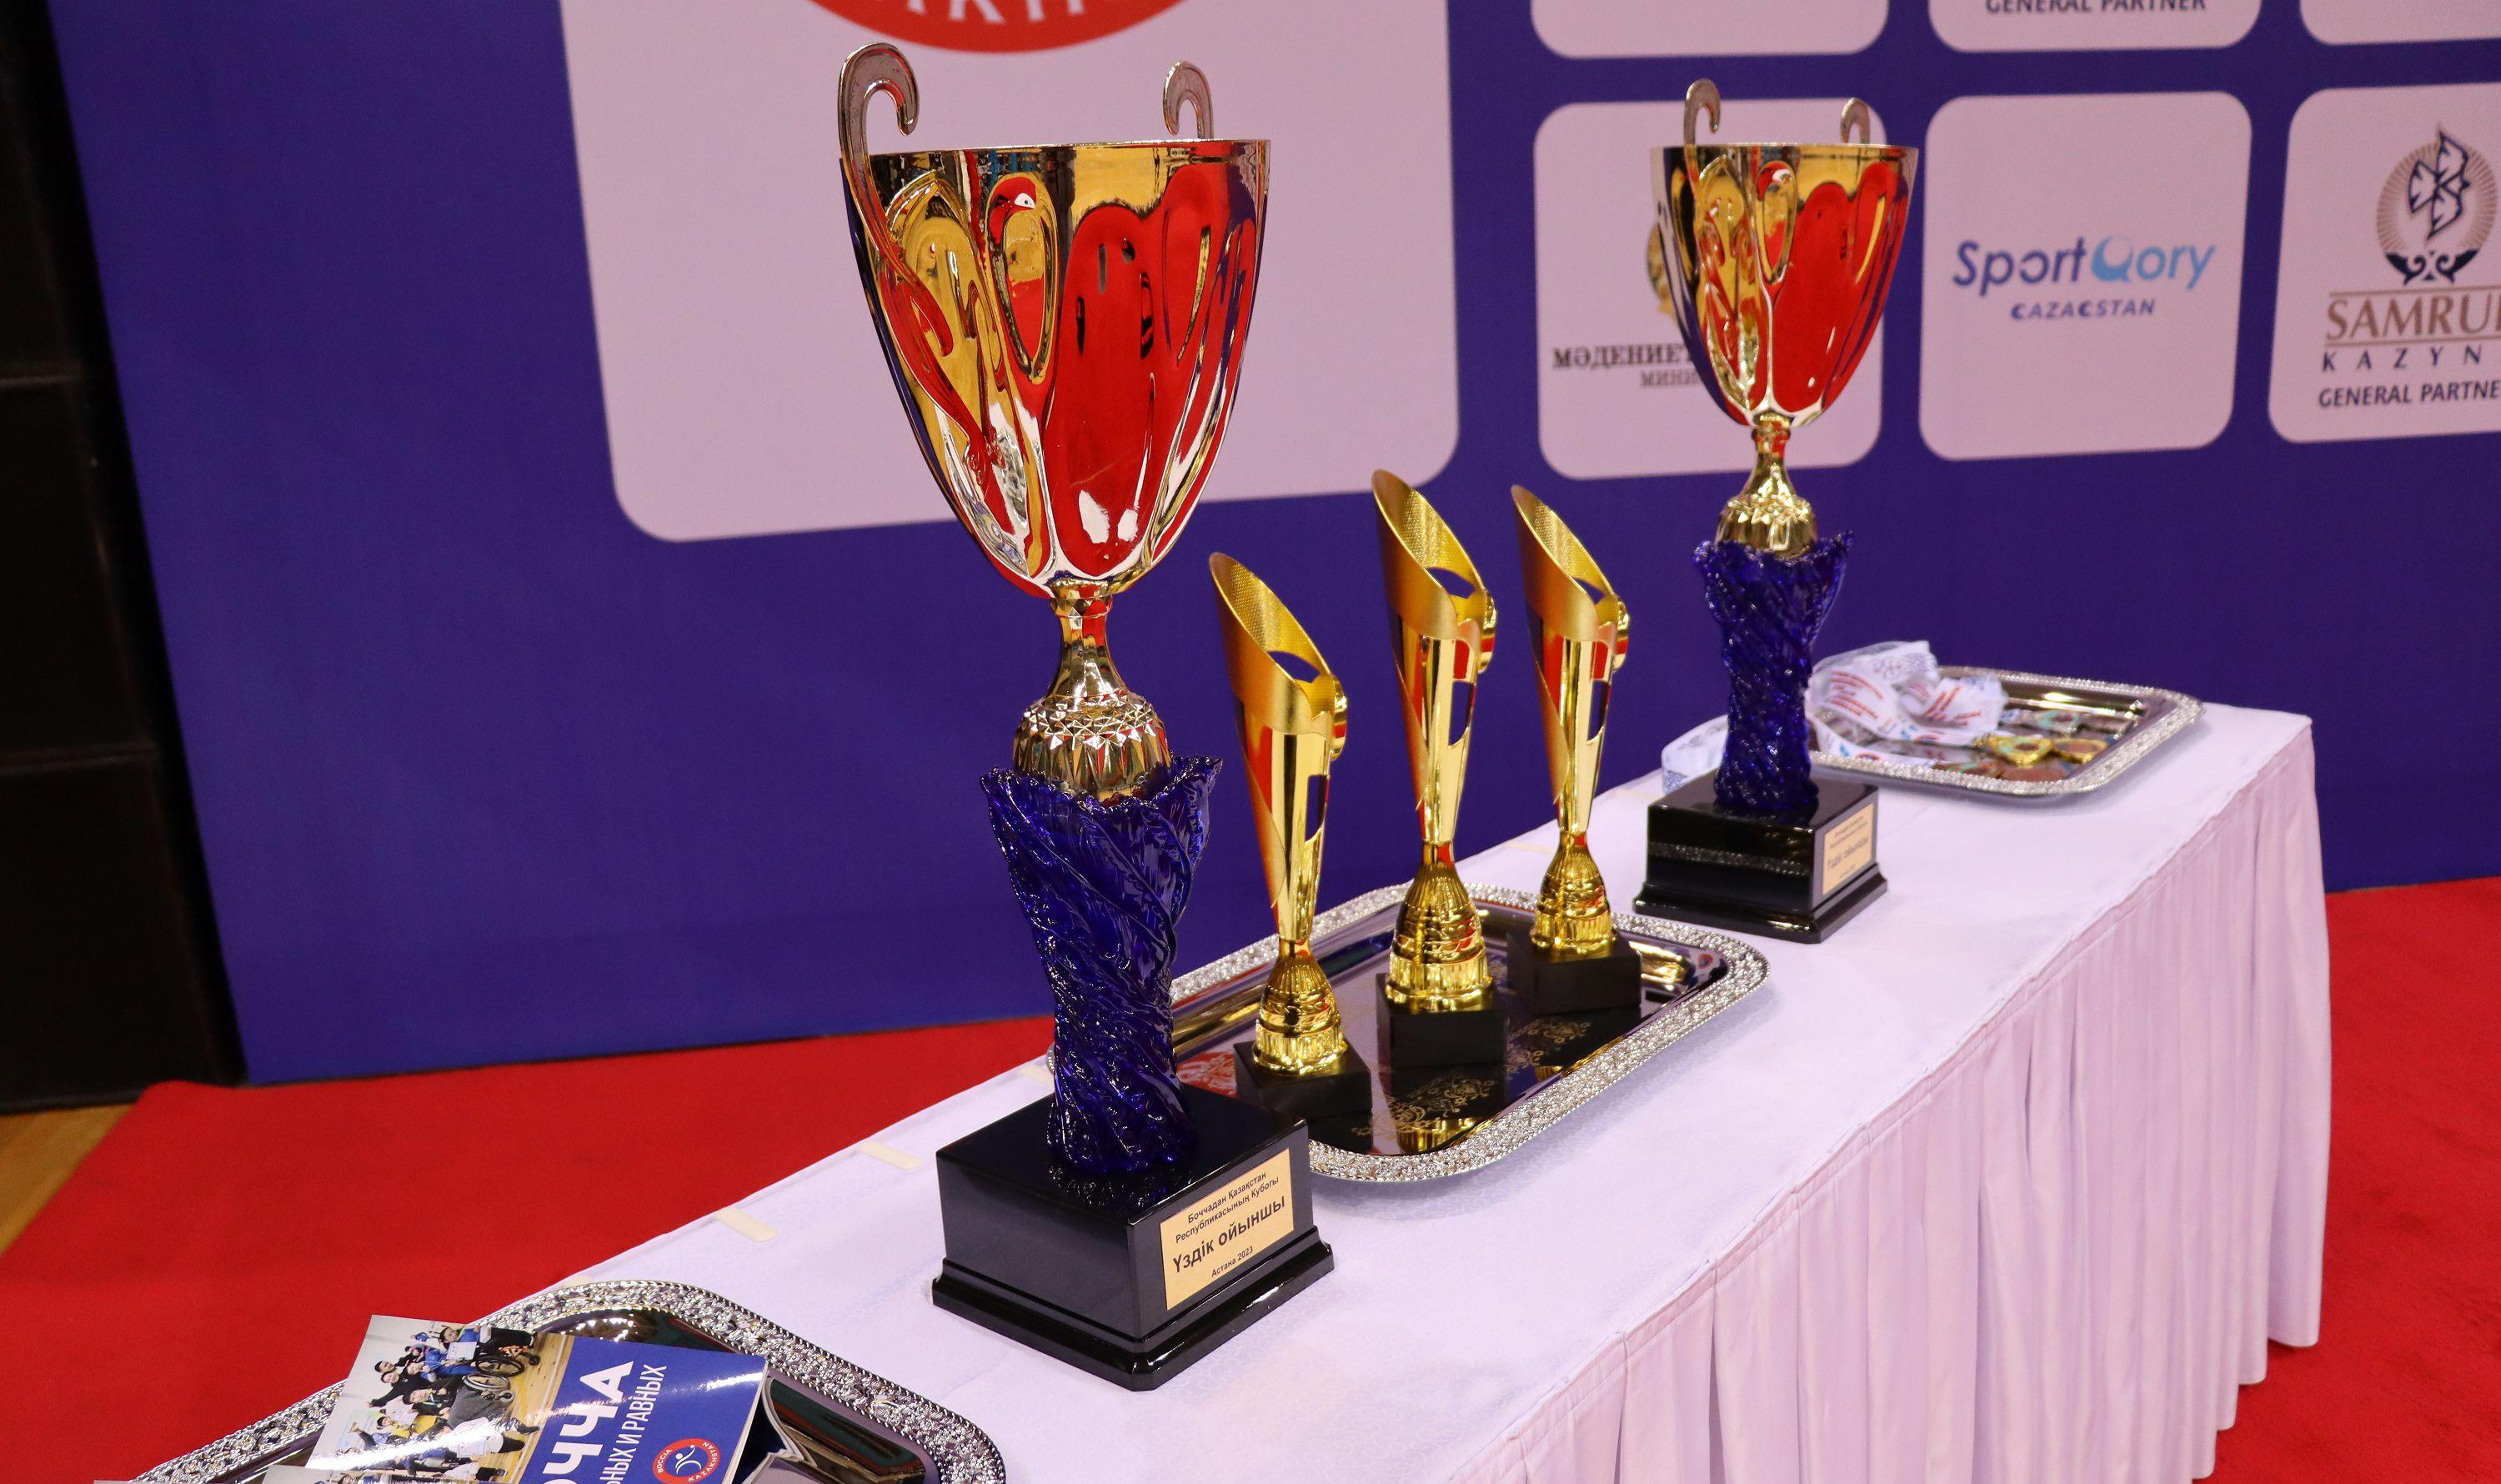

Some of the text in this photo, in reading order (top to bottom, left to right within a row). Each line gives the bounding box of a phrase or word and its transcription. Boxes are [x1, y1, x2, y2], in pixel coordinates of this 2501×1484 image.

[1952, 235, 2217, 298] SportQory
[1639, 368, 1700, 388] МИНИ
[2322, 344, 2501, 371] KAZYN
[2318, 379, 2501, 408] GENERAL PARTNE
[1175, 1176, 1279, 1244] Республикасының Кубогы
[1188, 1171, 1266, 1224] Боччадан Қазақстан
[1172, 1196, 1285, 1274] Үздік ойыншы
[1211, 1246, 1253, 1278] Астана 2023
[622, 1364, 667, 1431] РАВНЫХ
[543, 1361, 634, 1484] ЧЧА
[615, 1433, 643, 1444] И
[657, 1449, 672, 1473] BOCCIA
[688, 1441, 718, 1482] KAZAKHSTAN
